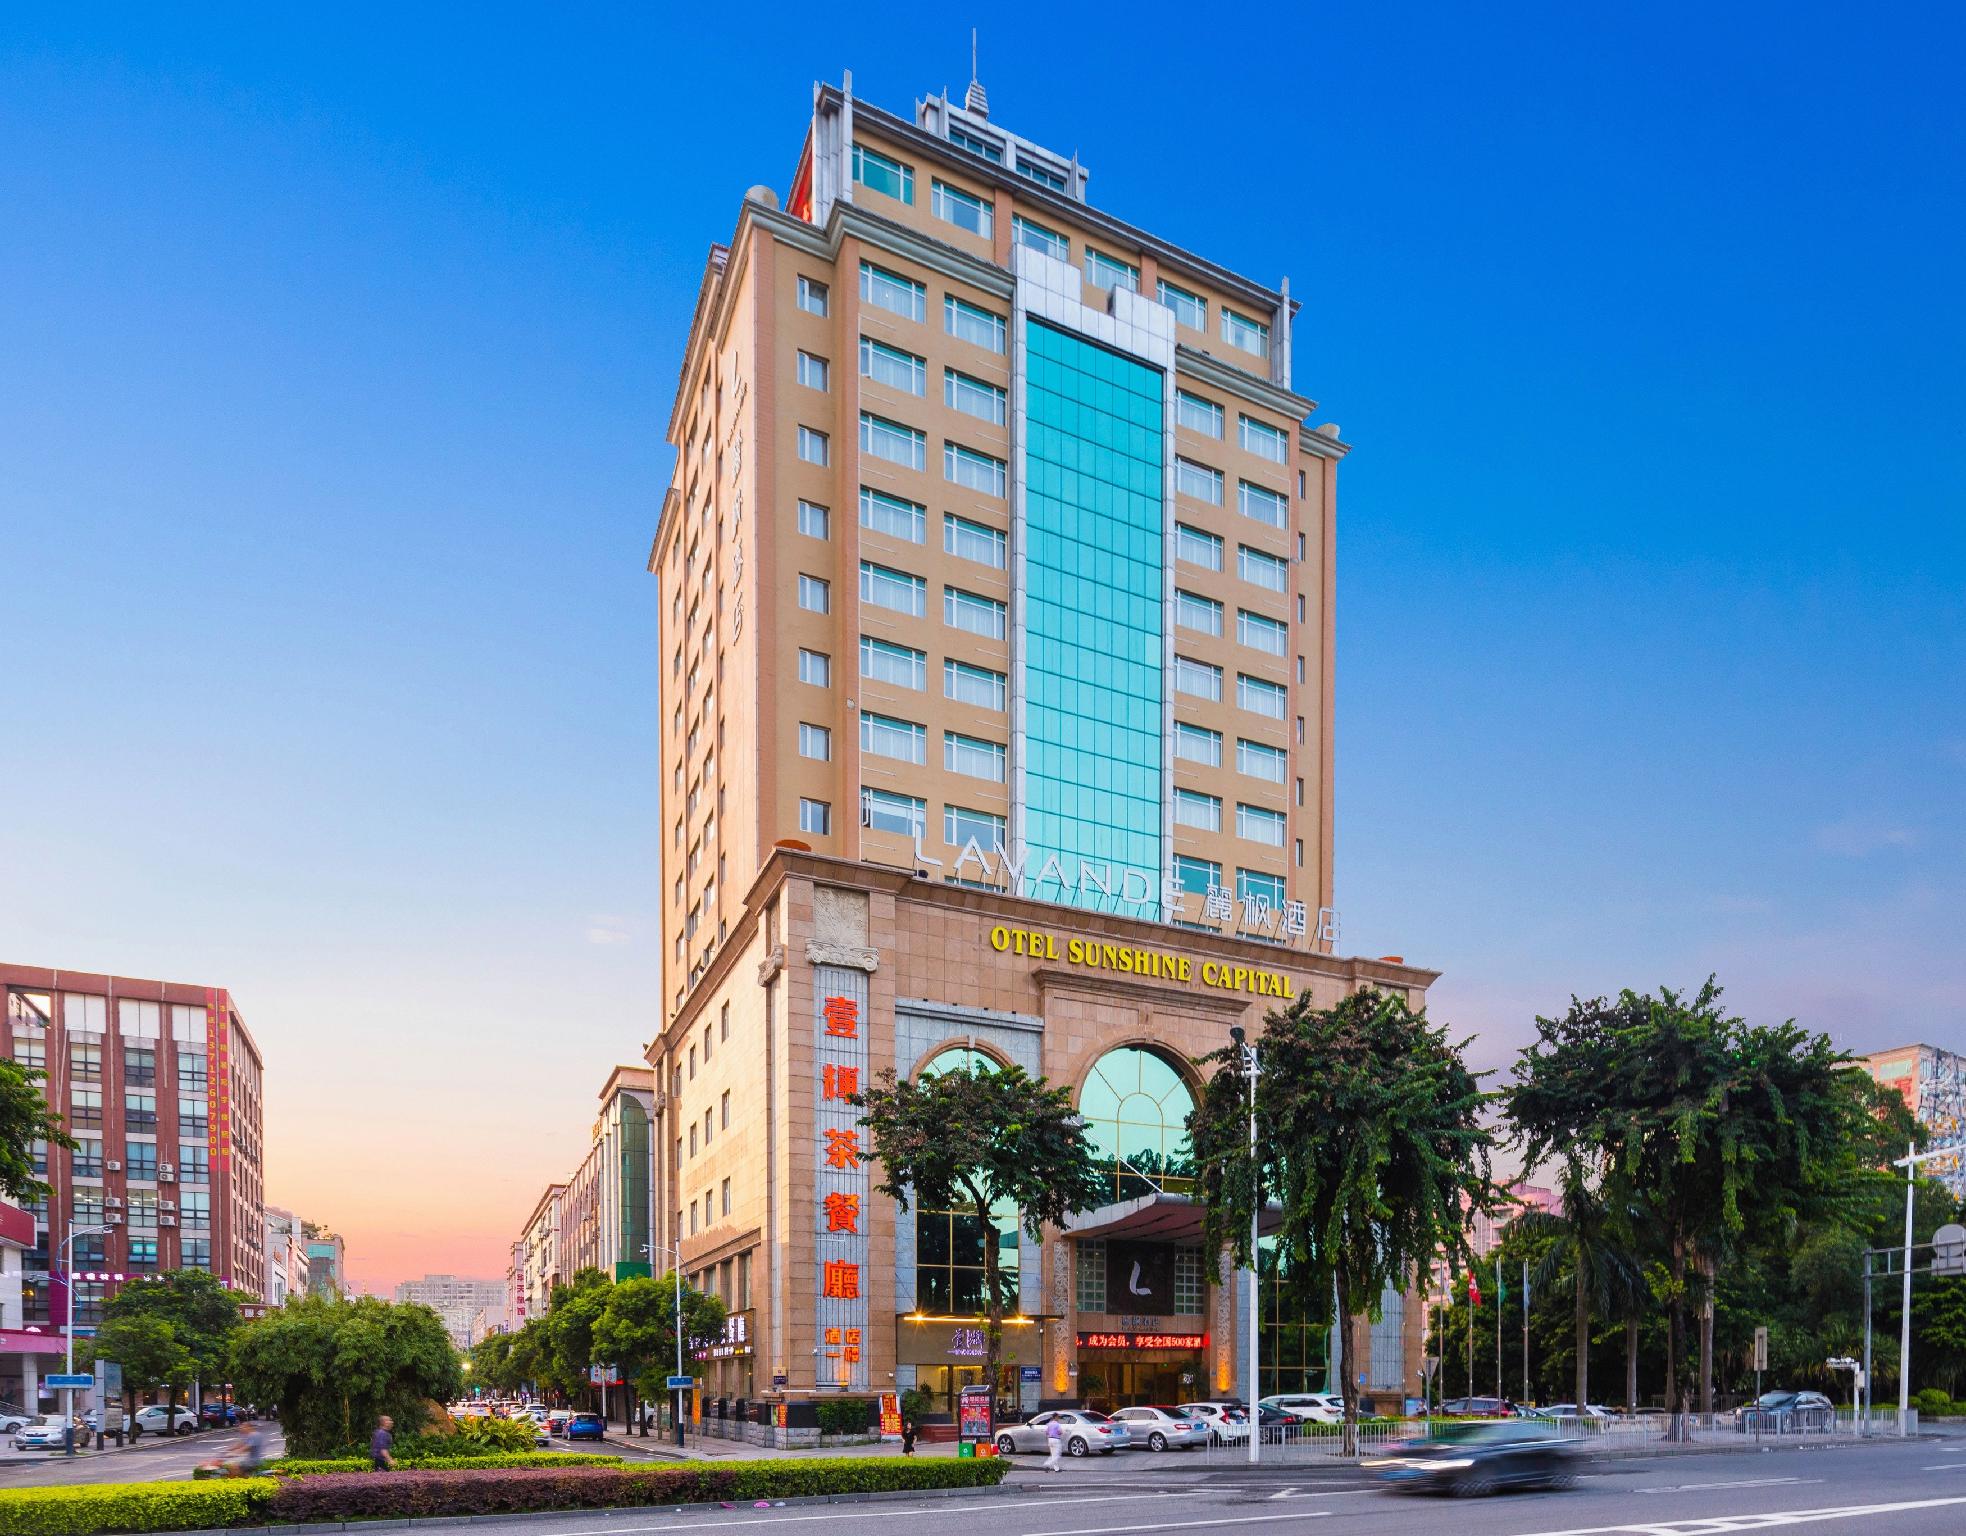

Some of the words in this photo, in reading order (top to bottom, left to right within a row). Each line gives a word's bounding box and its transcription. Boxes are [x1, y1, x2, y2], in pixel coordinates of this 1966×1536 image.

[914, 823, 1186, 913] LAVANDE
[990, 925, 1060, 961] OTEL
[1068, 938, 1193, 983] SUNSHINE
[1202, 961, 1296, 1000] CAPITAL
[825, 1327, 861, 1345] 酒店
